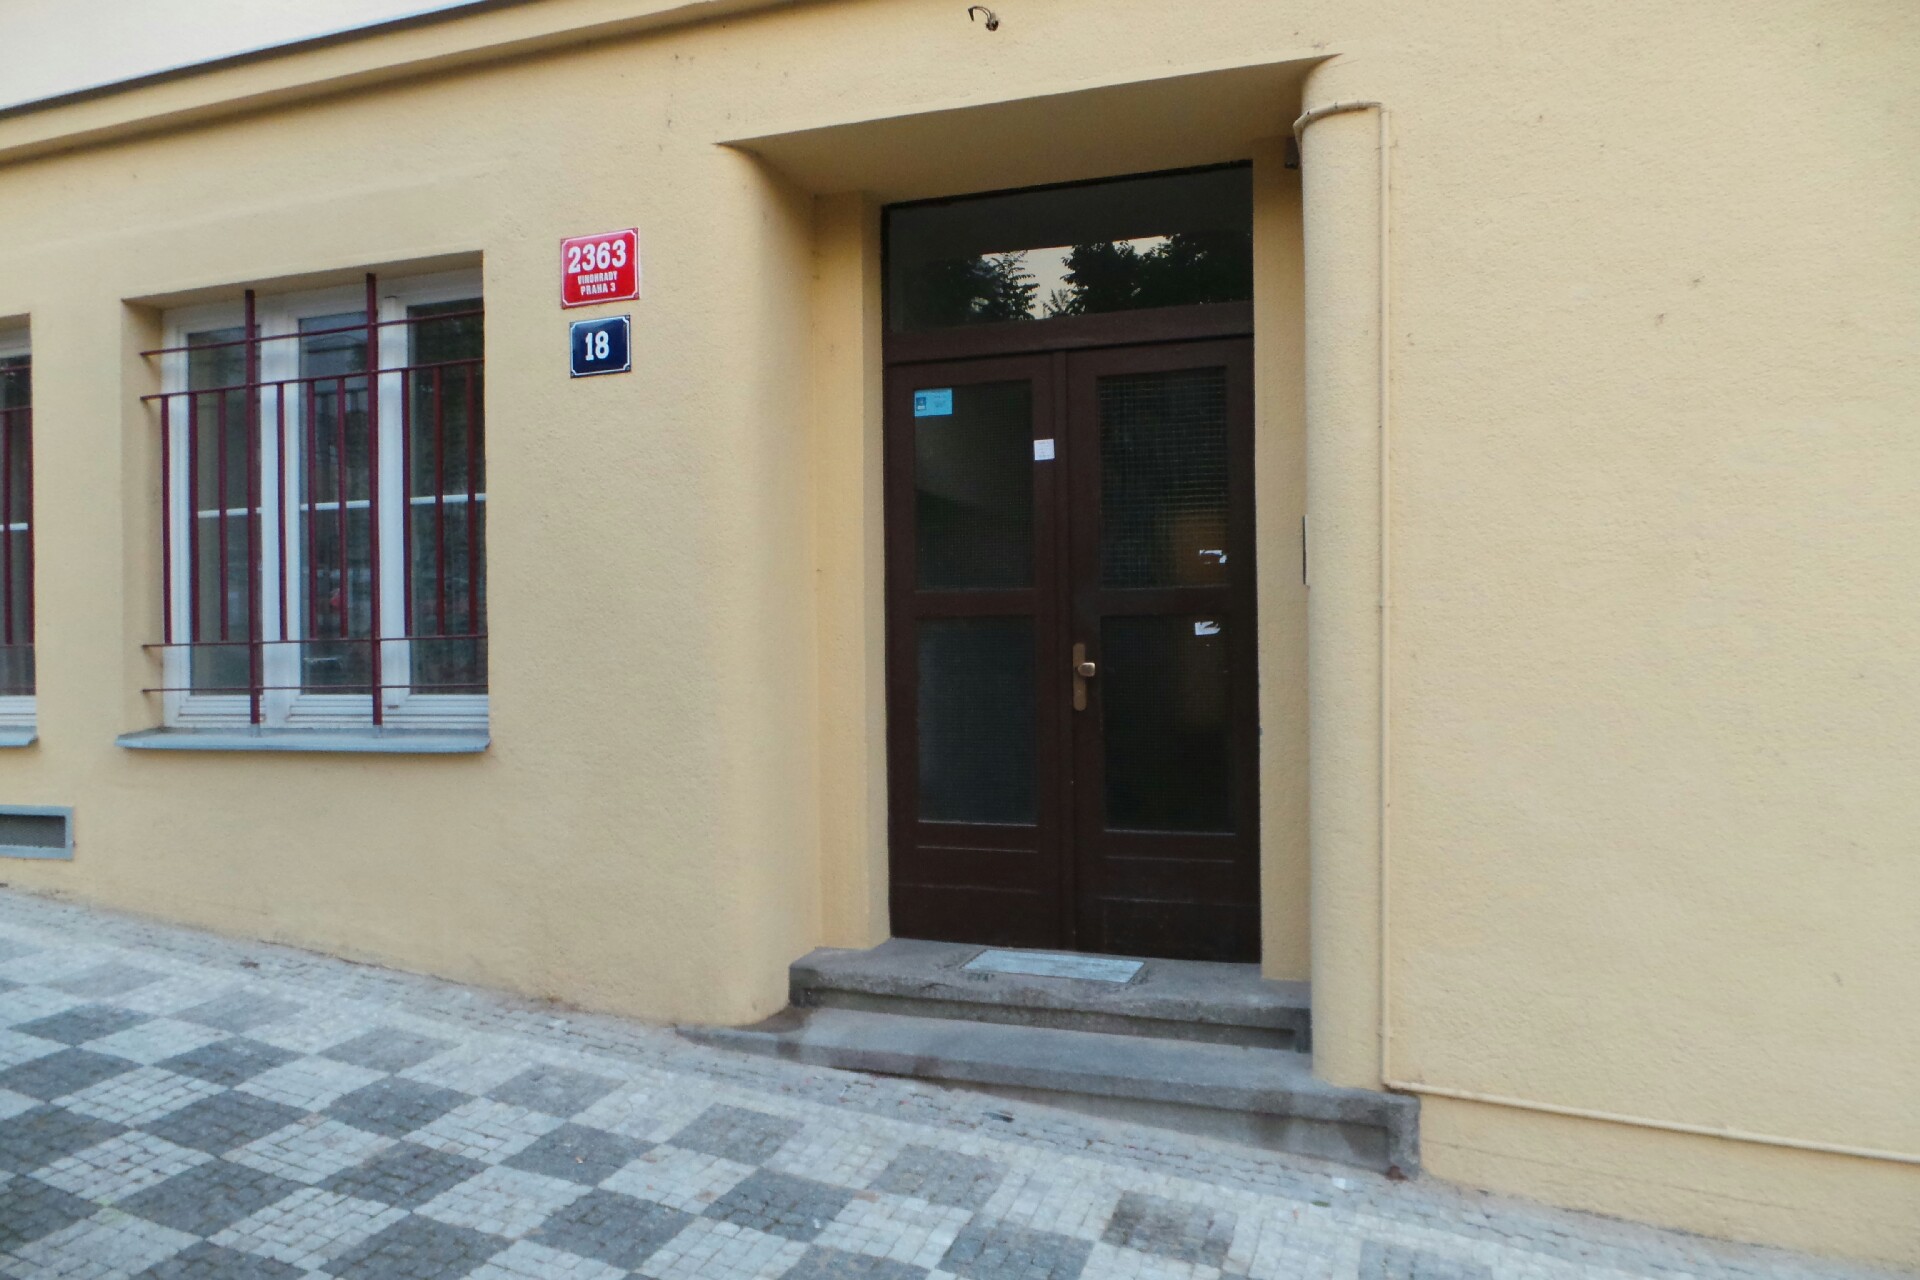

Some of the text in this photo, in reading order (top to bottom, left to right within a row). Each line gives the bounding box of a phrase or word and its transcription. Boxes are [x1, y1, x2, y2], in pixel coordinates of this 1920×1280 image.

[568, 240, 626, 273] 2363
[577, 271, 618, 285] VINOHRADY
[580, 282, 616, 296] PRAHA 3
[585, 330, 609, 361] 18
